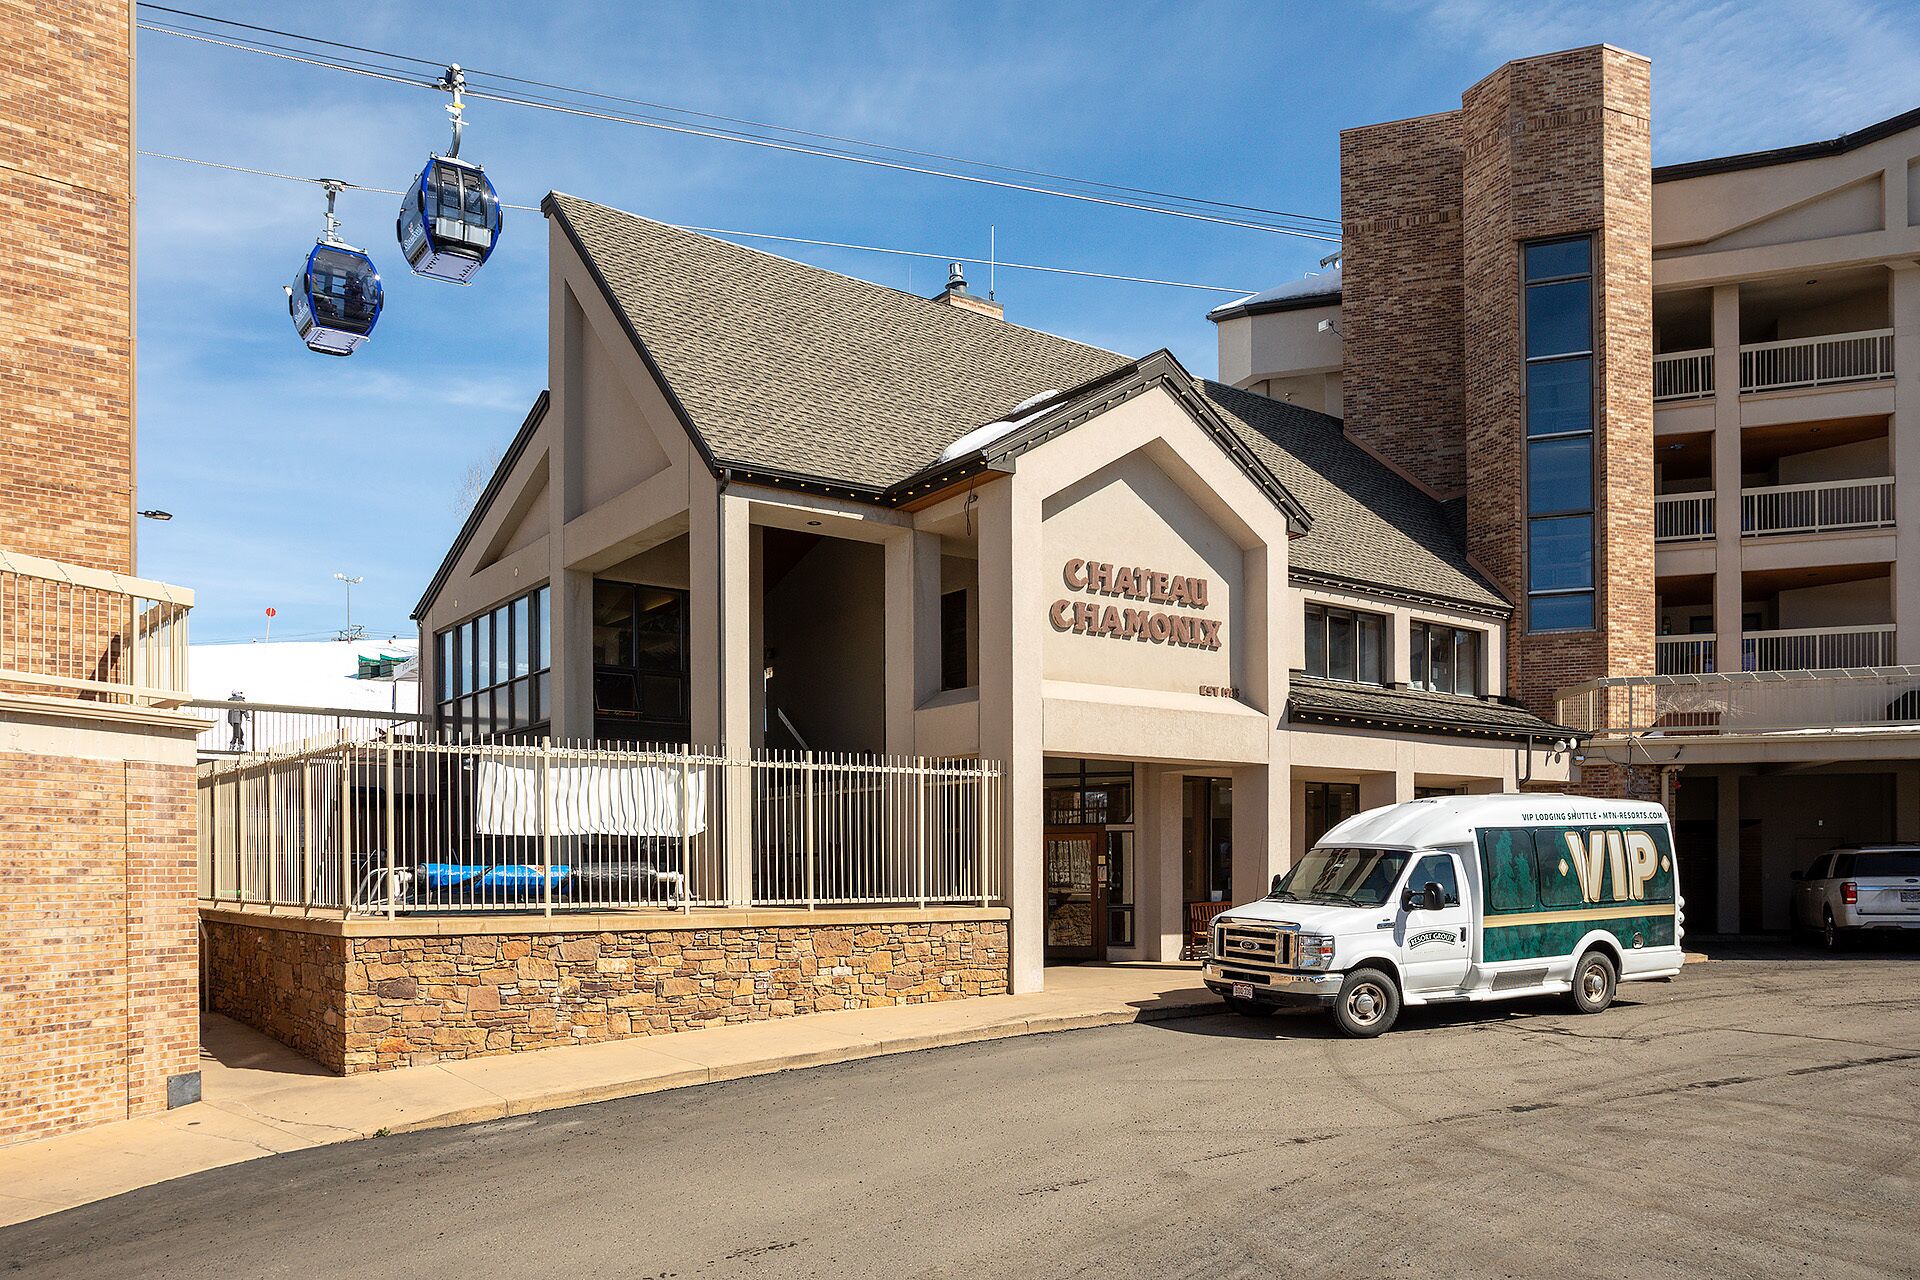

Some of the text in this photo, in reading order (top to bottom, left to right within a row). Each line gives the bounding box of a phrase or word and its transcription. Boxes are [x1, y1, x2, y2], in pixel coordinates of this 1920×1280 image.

[1063, 558, 1209, 610] CHATEAU
[1049, 599, 1222, 652] CHAMONIX
[1199, 685, 1219, 697] EST
[1521, 811, 1663, 821] VIP LODGING SHUTTLE MTN-RESORTS.COM
[1564, 830, 1658, 903] VIP
[1410, 932, 1454, 947] RESORT GROUP
